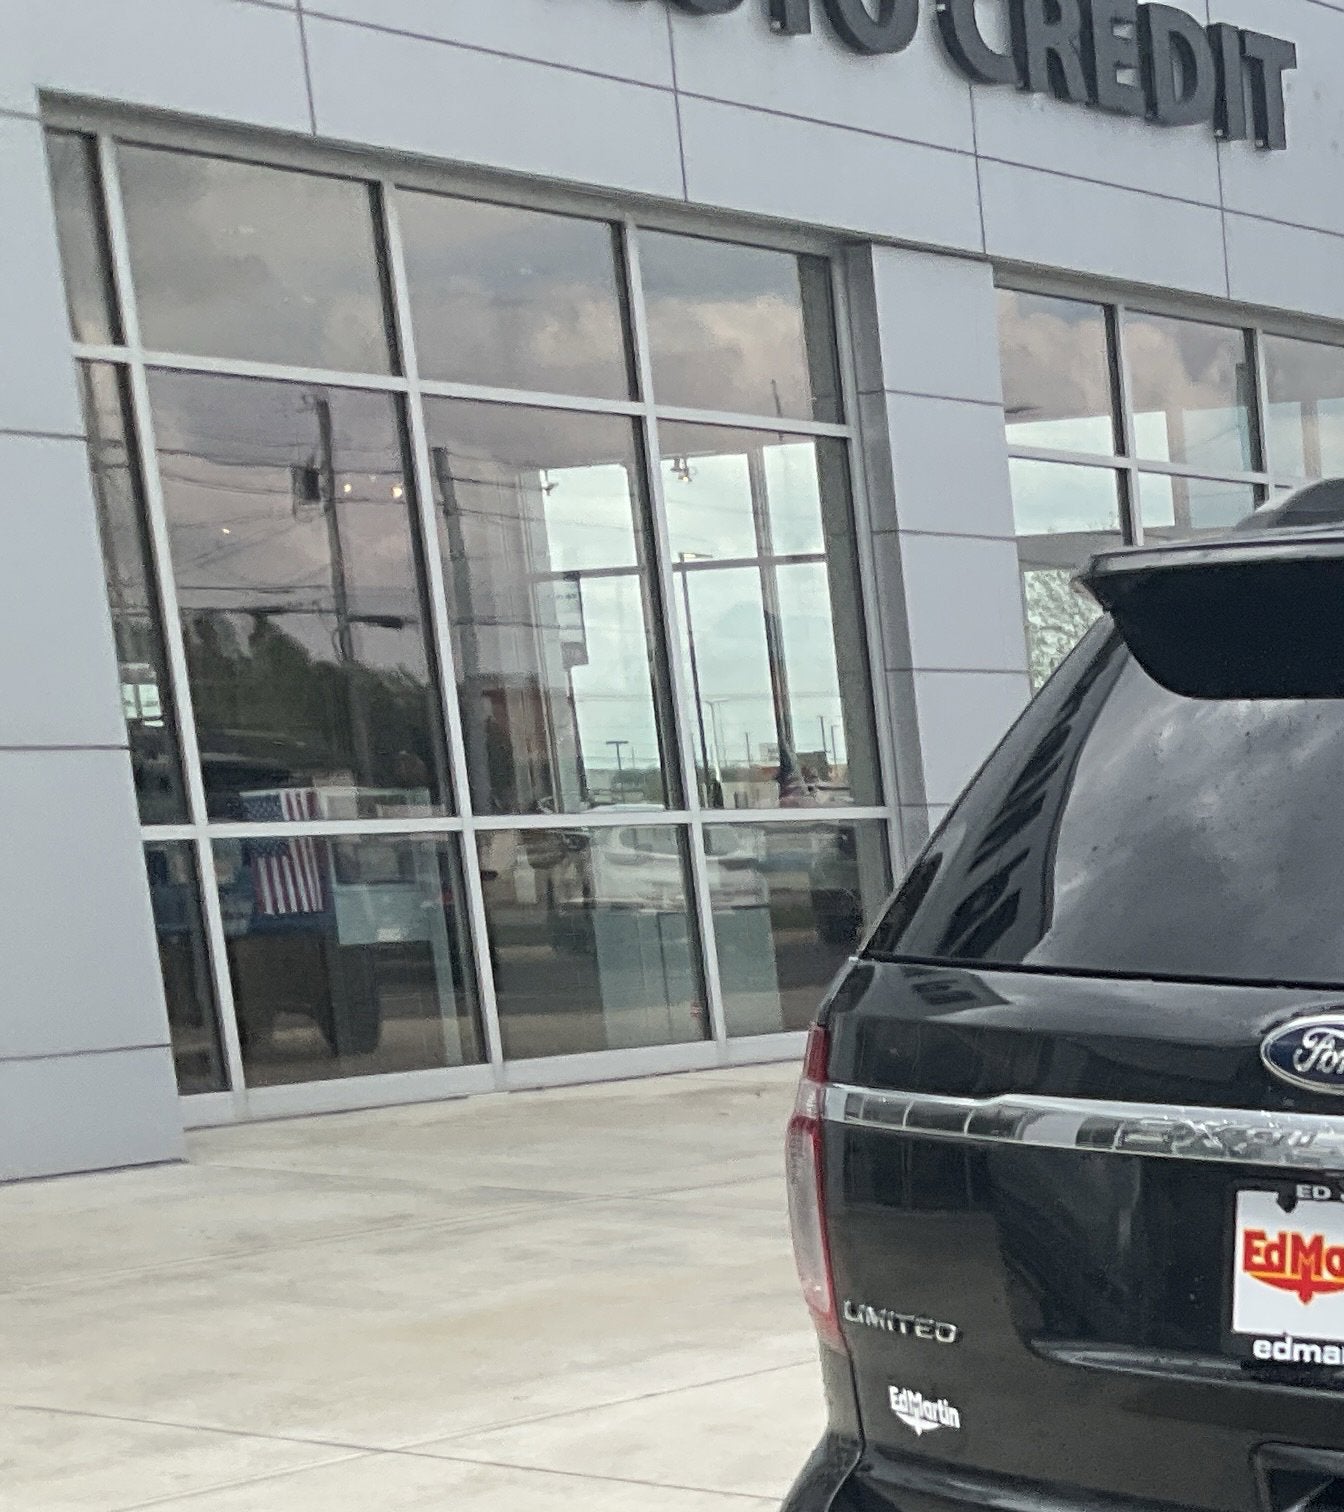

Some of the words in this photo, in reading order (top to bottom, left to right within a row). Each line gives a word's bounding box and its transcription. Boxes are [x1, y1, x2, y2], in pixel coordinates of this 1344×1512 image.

[934, 0, 1298, 151] CREDIT
[1296, 1184, 1331, 1199] ED
[843, 1300, 957, 1343] LIMITED
[888, 1385, 961, 1436] EdMartin
